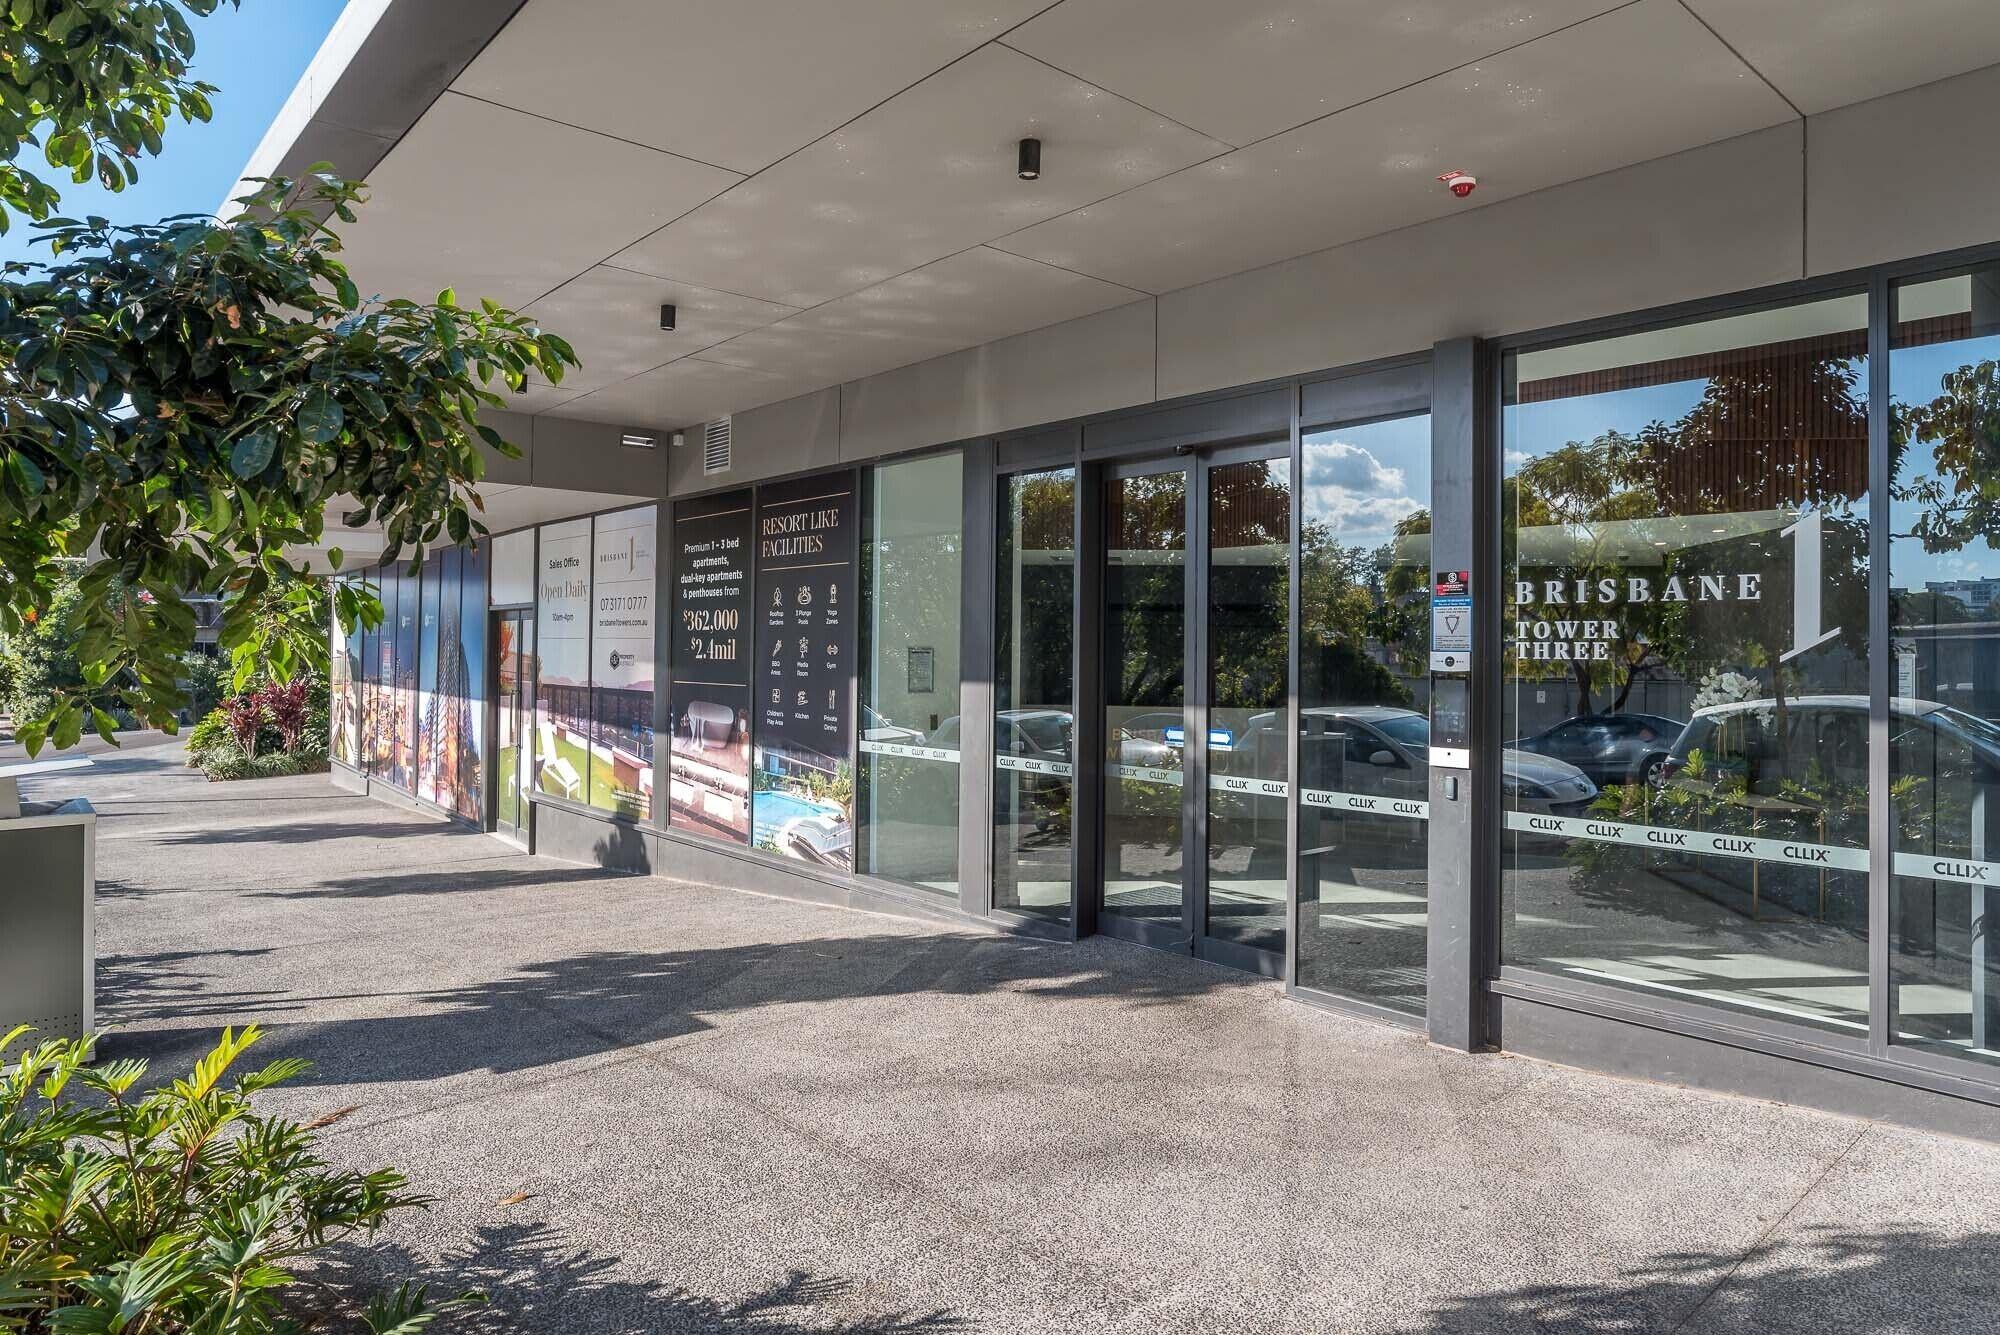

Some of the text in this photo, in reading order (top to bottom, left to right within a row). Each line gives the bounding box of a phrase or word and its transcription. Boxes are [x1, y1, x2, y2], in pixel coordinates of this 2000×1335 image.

[763, 509, 839, 535] RESORT LIKE
[684, 543, 710, 553] Premium
[720, 539, 725, 549] 3
[726, 537, 740, 548] bed
[762, 534, 823, 558] FACILITIES
[549, 557, 580, 569] Sales Office
[692, 556, 730, 568] apartments,
[680, 570, 743, 583] dual-key apartments
[540, 580, 589, 603] Open Daily
[682, 585, 740, 599] & penthouses from
[1515, 573, 1762, 605] BRISBANE
[683, 608, 739, 634] $362,000
[1515, 620, 1621, 640] TOWER
[690, 636, 736, 660] $2.4mil
[1515, 641, 1609, 660] THREE
[823, 714, 838, 723] Private
[823, 723, 837, 733] Dining
[1024, 761, 1041, 771] CLLIX
[1051, 764, 1069, 774] CLLIX
[1226, 779, 1286, 794] CLLIX CLLIX
[1306, 792, 1422, 815] CLLIX CLLIX CLLIX
[1529, 817, 1830, 863] CLLIX CLLIX CLLIX CLLIX CLLIX
[1933, 862, 1988, 880] CLLIX
